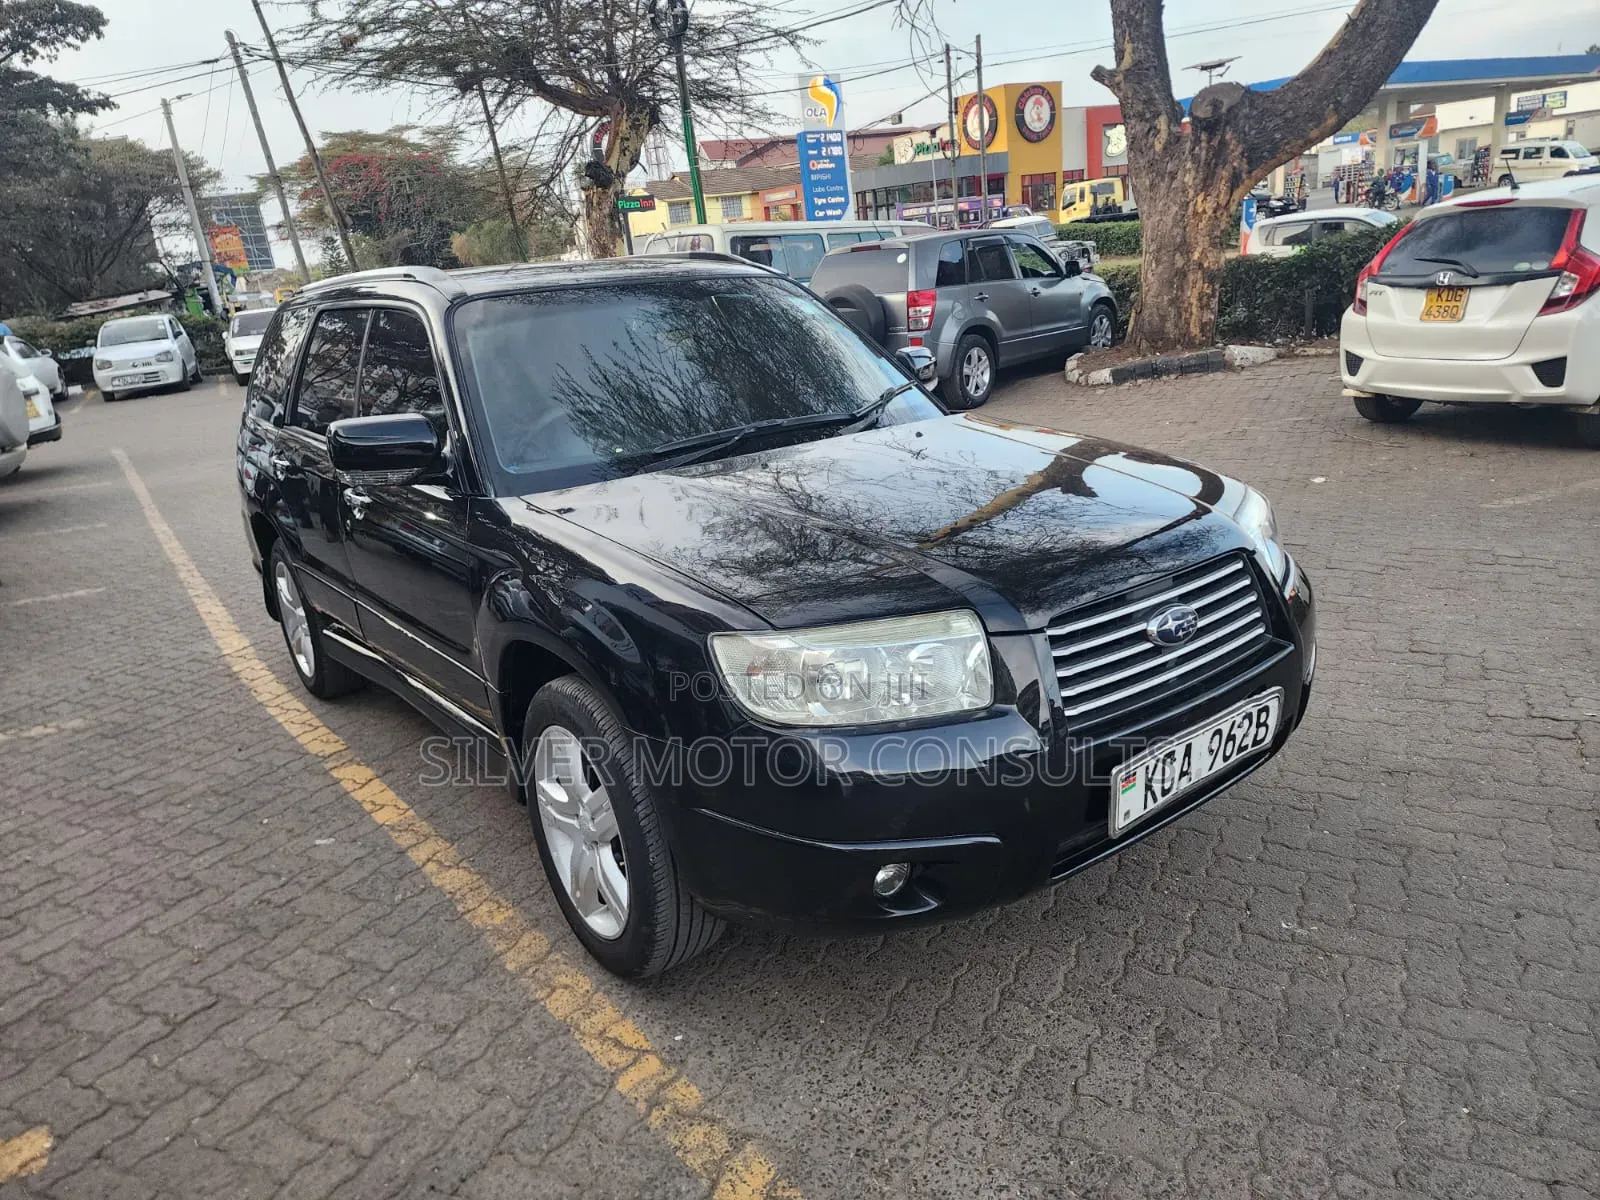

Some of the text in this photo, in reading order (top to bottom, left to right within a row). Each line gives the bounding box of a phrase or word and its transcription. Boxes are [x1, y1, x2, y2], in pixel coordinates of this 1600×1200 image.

[806, 107, 827, 117] OLA
[812, 185, 826, 193] Lube
[813, 196, 845, 206] Tyre Centre
[826, 208, 843, 217] Wash
[1435, 287, 1464, 303] KDG
[1424, 304, 1460, 319] 438Q
[1207, 704, 1271, 773] 962B
